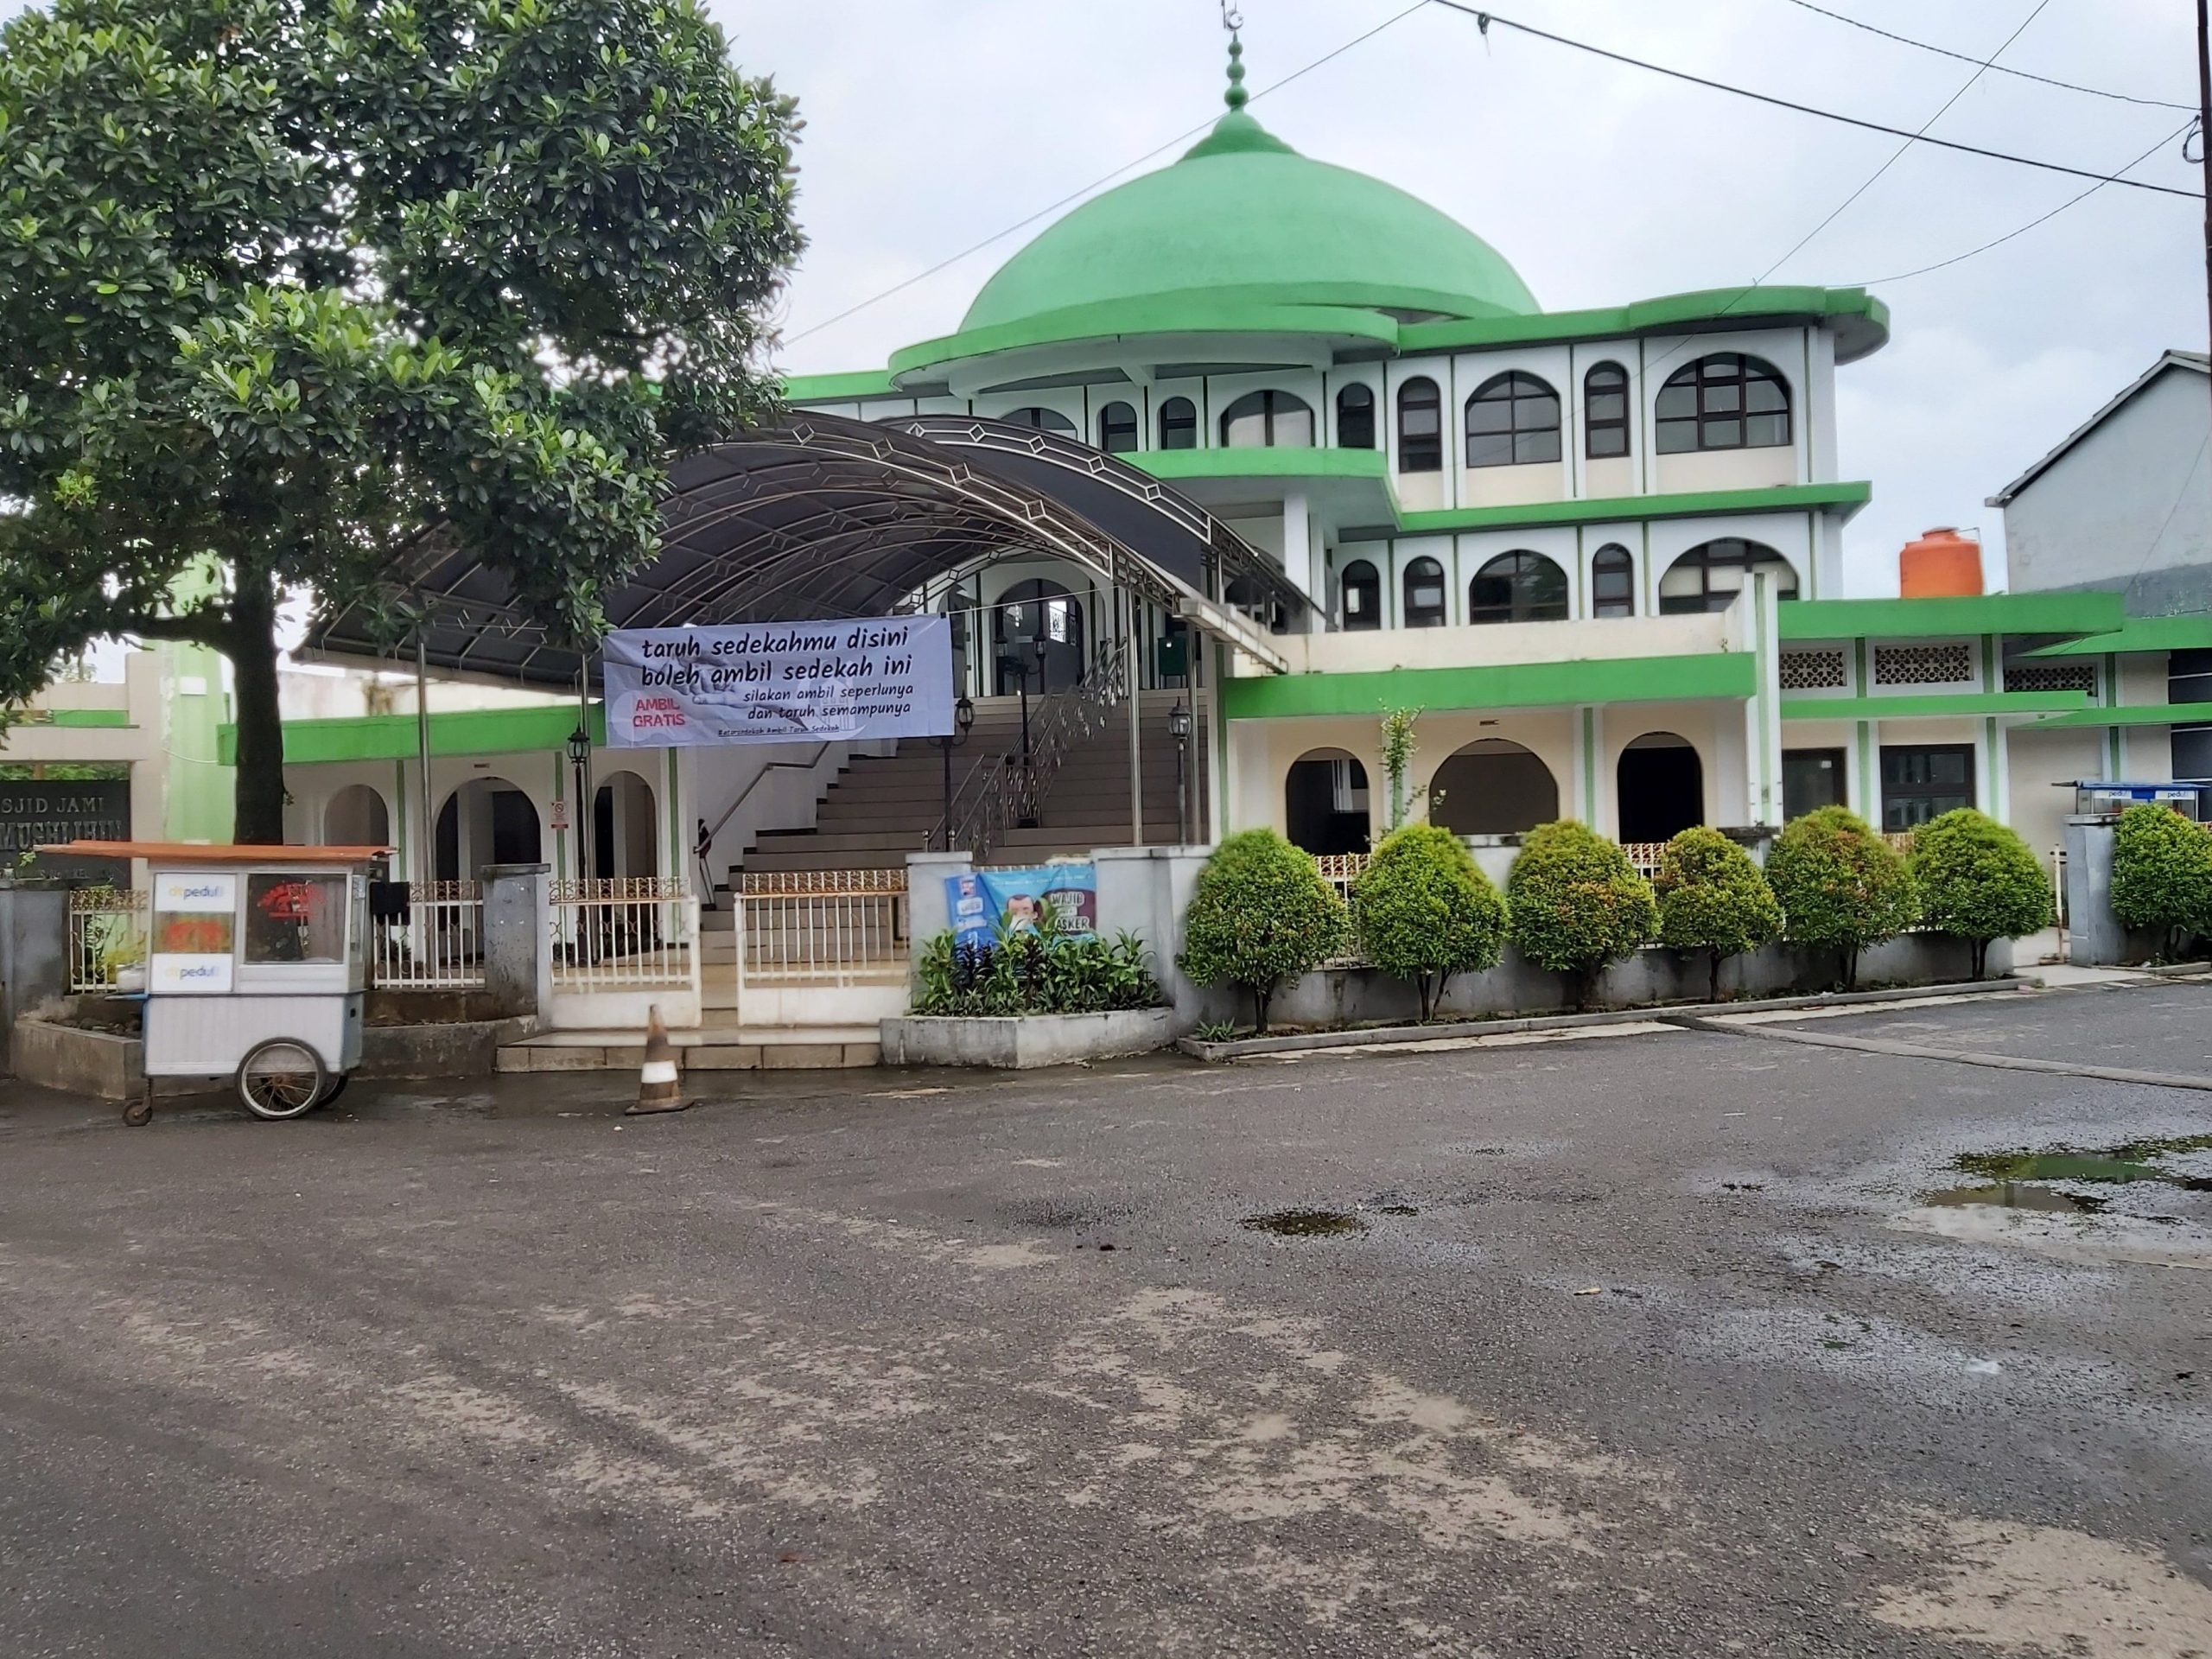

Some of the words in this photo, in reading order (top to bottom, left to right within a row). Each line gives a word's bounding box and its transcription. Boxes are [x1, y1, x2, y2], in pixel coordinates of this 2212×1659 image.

[642, 634, 701, 658] taruh
[711, 630, 837, 656] sedekahmu
[847, 626, 908, 649] disini
[642, 663, 701, 686] boleh
[710, 659, 772, 683] ambil
[783, 655, 873, 680] sedekah
[884, 653, 912, 676] ini
[743, 687, 791, 702] silakan
[797, 685, 835, 700] ambil
[840, 683, 913, 701] seperlunya
[635, 697, 681, 711] AMBIL
[747, 705, 772, 720] dan
[779, 704, 815, 719] taruh
[822, 702, 911, 719] semampunya
[632, 713, 685, 728] GRATIS
[56, 797, 104, 812] JAMI
